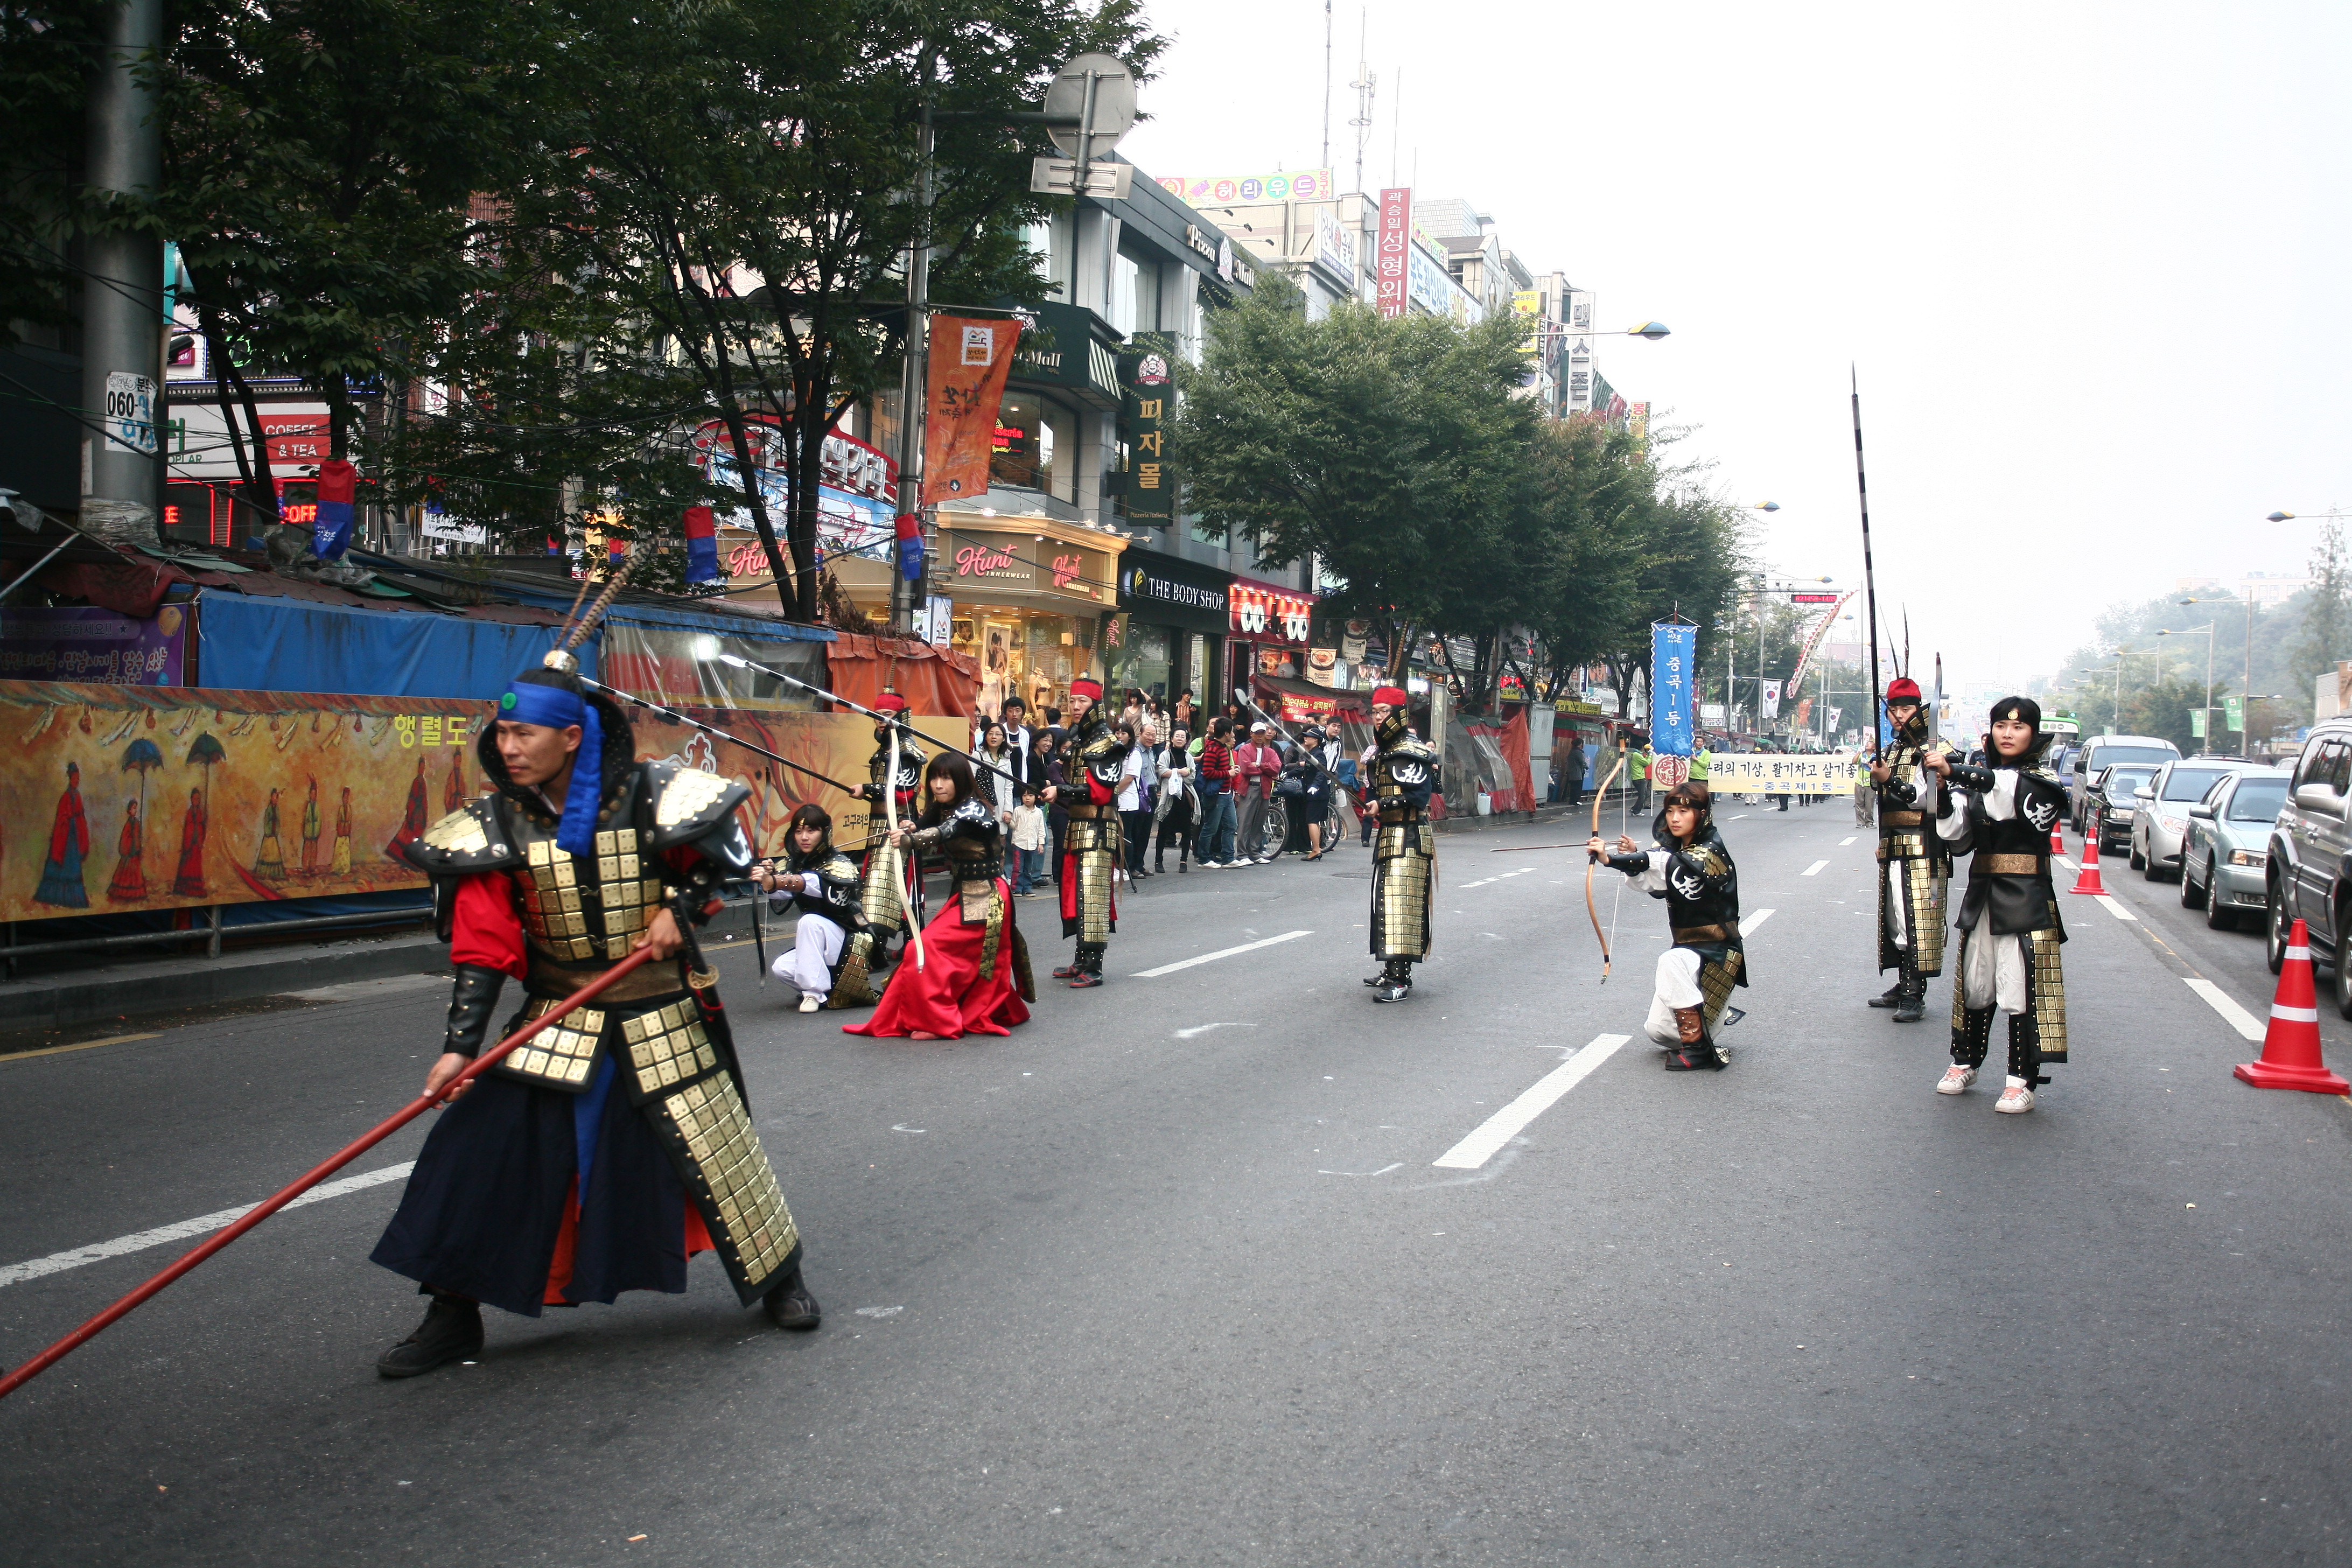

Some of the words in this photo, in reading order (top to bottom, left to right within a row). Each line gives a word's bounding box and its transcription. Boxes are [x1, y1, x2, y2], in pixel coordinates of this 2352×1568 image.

[1217, 179, 1314, 198] 허리우드
[1319, 170, 1328, 200] 당구장
[1387, 192, 1403, 229] 곽승일
[1186, 224, 1215, 262] Pizza
[265, 424, 317, 437] COFFEE
[1137, 398, 1164, 489] 피자몰
[278, 444, 287, 457] &
[291, 444, 317, 457] TEA
[956, 544, 1018, 577] Hunt
[986, 571, 1031, 579] INNERWEAR
[1053, 554, 1082, 588] Hunt
[1066, 582, 1090, 593] INNERWEAR
[1149, 577, 1170, 599] THE
[1173, 583, 1199, 605] BODY
[1199, 590, 1224, 611] SHOP
[1, 623, 46, 636] 생님들과
[1107, 619, 1120, 648] Hunt
[394, 713, 467, 748] 행렬도
[1740, 761, 1766, 778] 기상,
[1772, 762, 1817, 778] 활기차고
